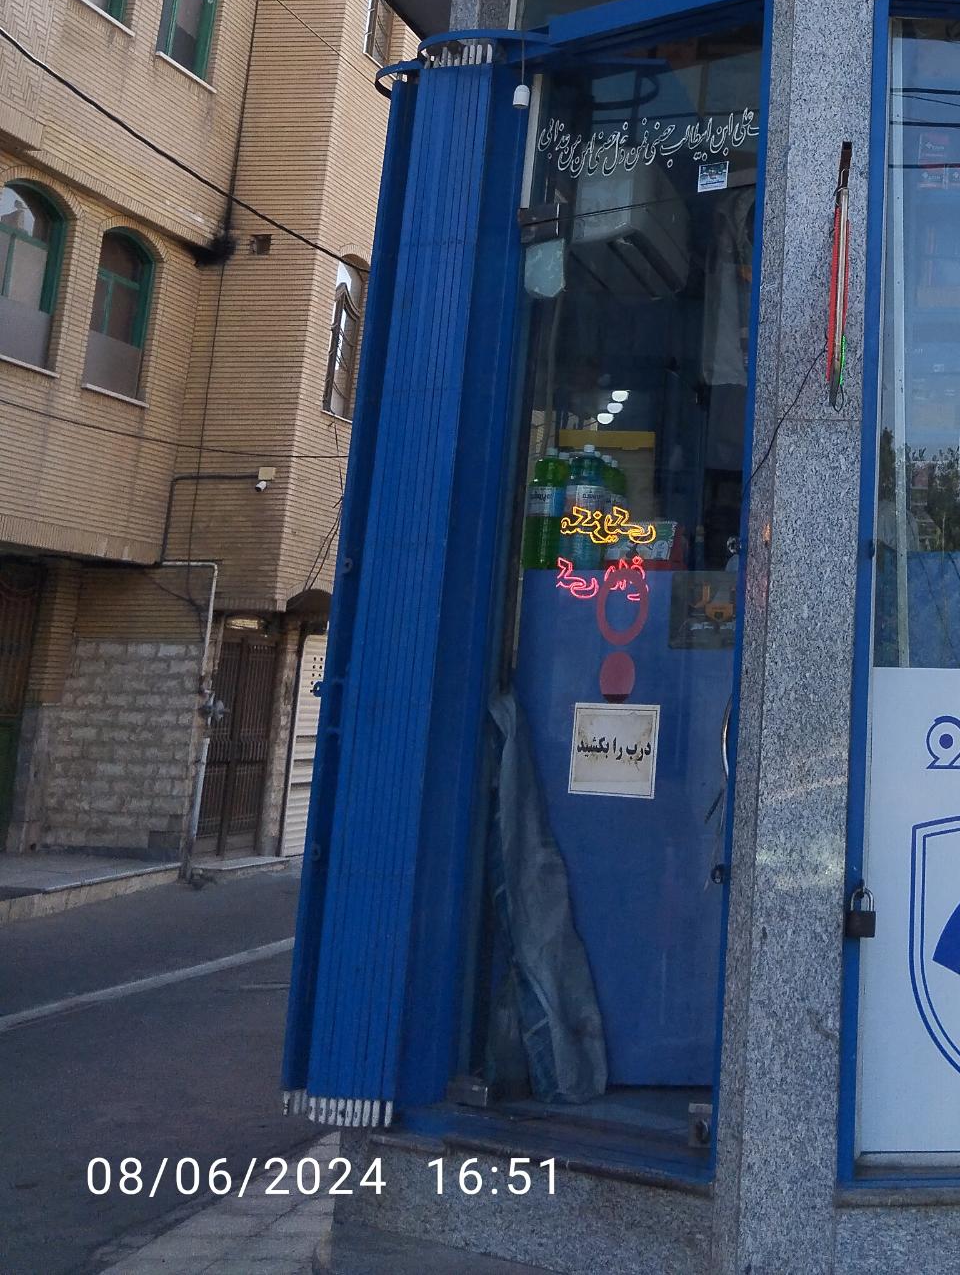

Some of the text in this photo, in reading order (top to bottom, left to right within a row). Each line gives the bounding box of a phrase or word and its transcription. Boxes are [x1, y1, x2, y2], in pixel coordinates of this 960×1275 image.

[576, 736, 652, 762] درب را بکشید
